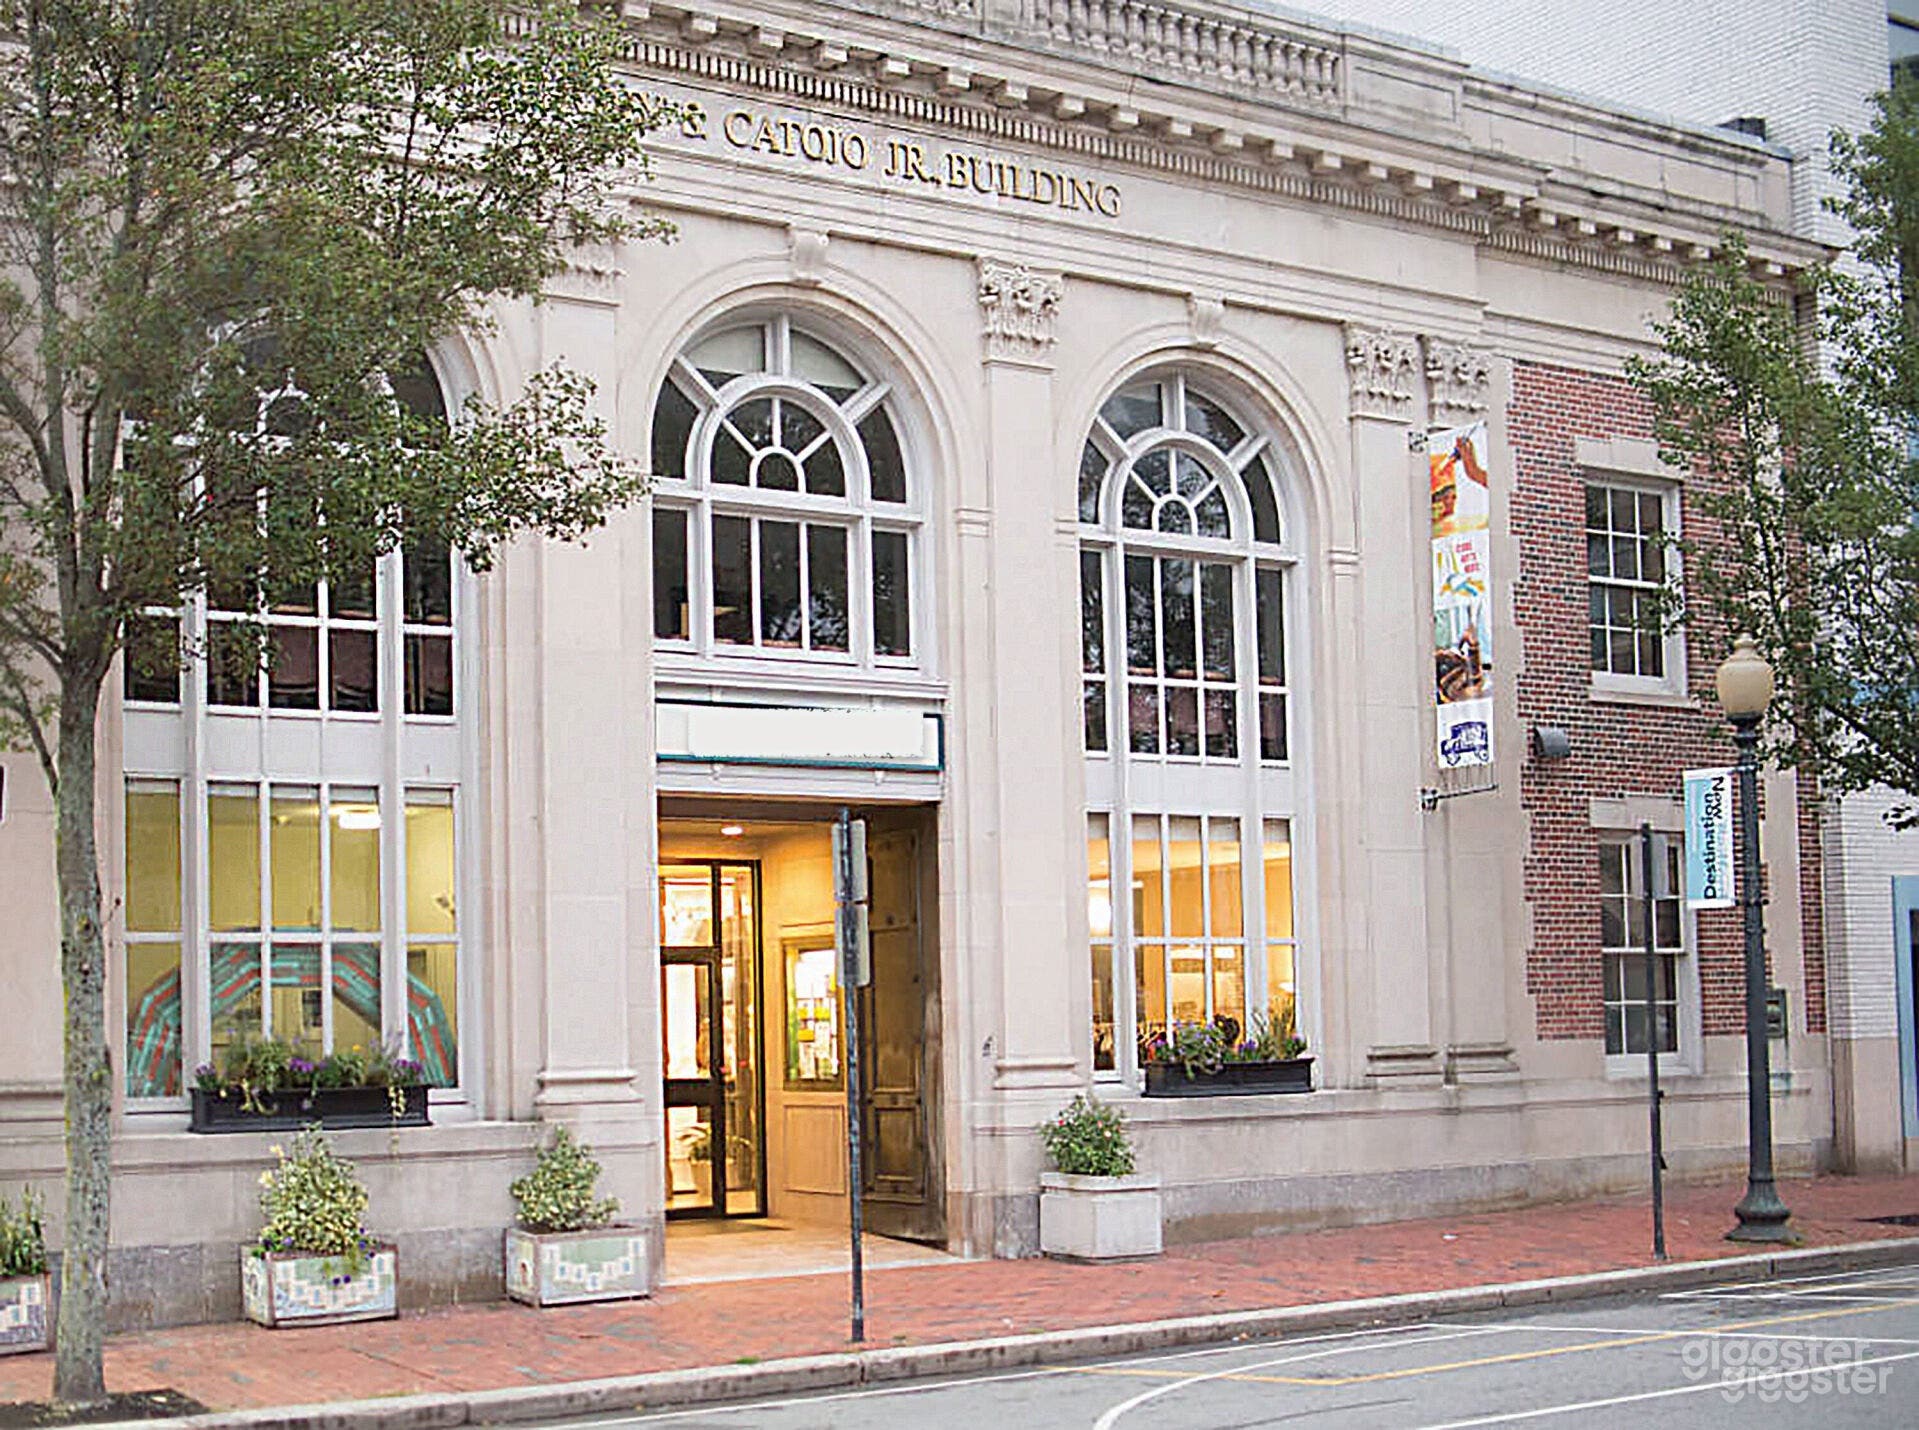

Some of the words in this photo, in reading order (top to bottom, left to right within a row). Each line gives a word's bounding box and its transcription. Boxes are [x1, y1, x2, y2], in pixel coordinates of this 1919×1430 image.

[884, 138, 941, 185] JR.
[946, 152, 1121, 218] BUILDING
[1701, 793, 1717, 899] Destination
